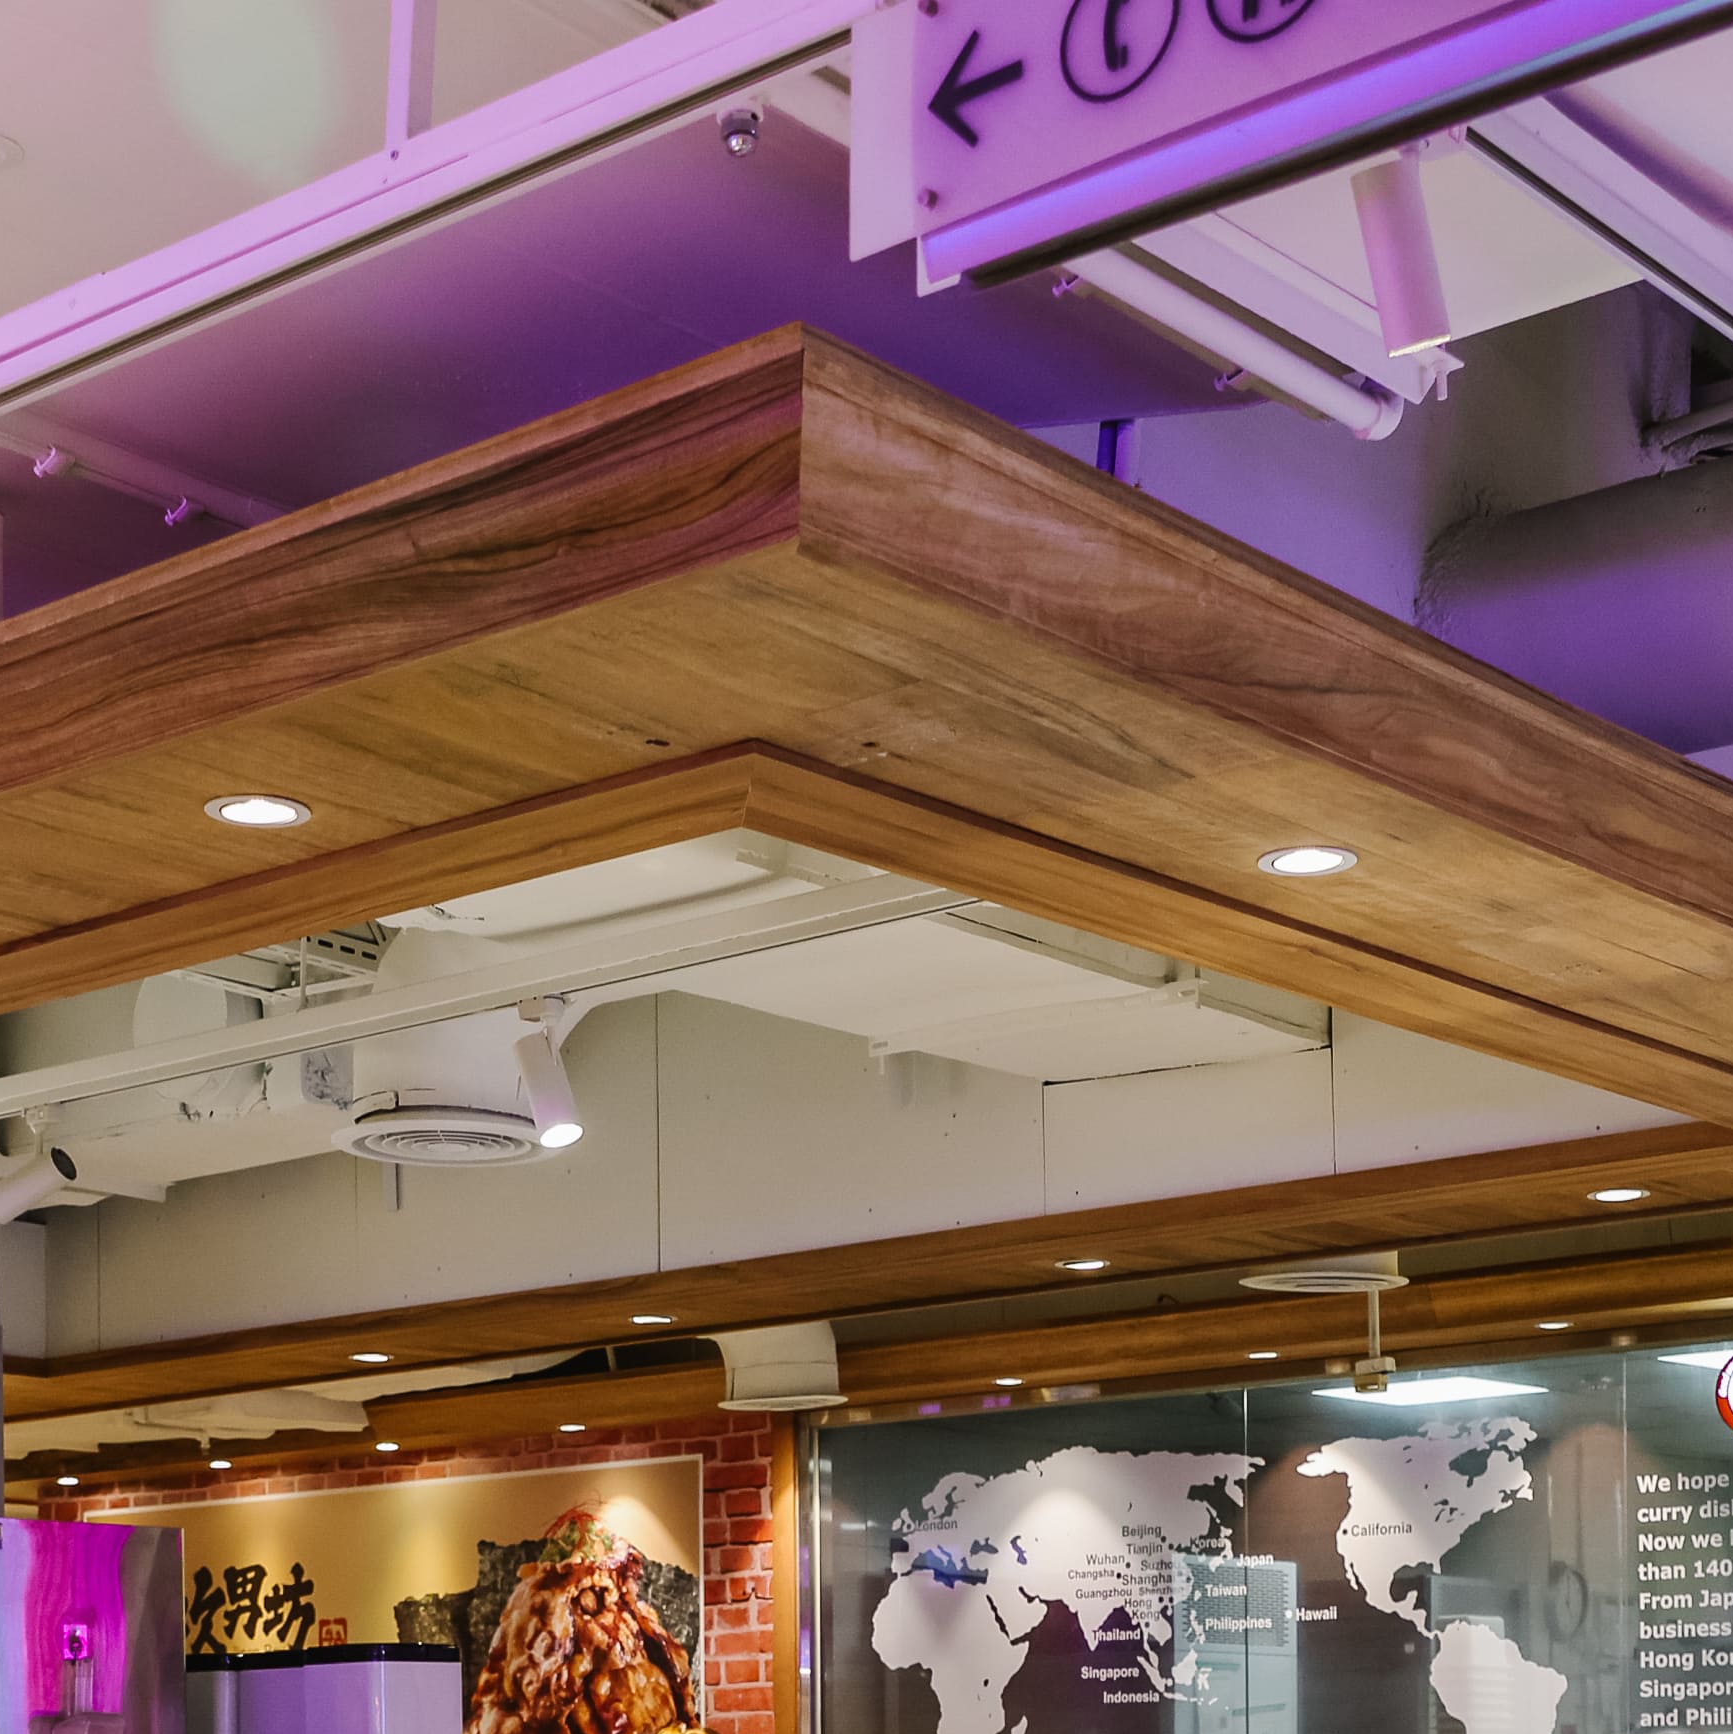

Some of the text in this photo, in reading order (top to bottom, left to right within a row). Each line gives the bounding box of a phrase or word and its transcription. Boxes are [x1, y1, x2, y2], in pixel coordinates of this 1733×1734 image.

[1636, 1474, 1671, 1494] We
[1677, 1472, 1729, 1492] hope
[1637, 1504, 1693, 1524] curry
[1122, 1525, 1162, 1540] Beijing
[1351, 1521, 1412, 1537] California
[1638, 1533, 1685, 1552] Now
[1691, 1531, 1723, 1548] we
[1127, 1543, 1163, 1556] Tianjin
[1086, 1554, 1125, 1566] Wuhan
[1236, 1553, 1274, 1568] Japan
[1068, 1568, 1115, 1580] Changsha
[1637, 1562, 1686, 1581] than
[1075, 1586, 1133, 1600] Guangzhou
[1205, 1583, 1247, 1597] Taiwan
[1125, 1598, 1152, 1610] Hong
[1639, 1591, 1693, 1610] From
[1132, 1610, 1160, 1621] Kong
[1295, 1606, 1338, 1621] Hawaii
[1205, 1616, 1272, 1632] Philippines
[1639, 1620, 1732, 1640] business
[1640, 1651, 1694, 1671] Hong
[1081, 1666, 1140, 1681] Singapore
[1103, 1690, 1160, 1704] Indonesia
[1640, 1709, 1678, 1727] and
